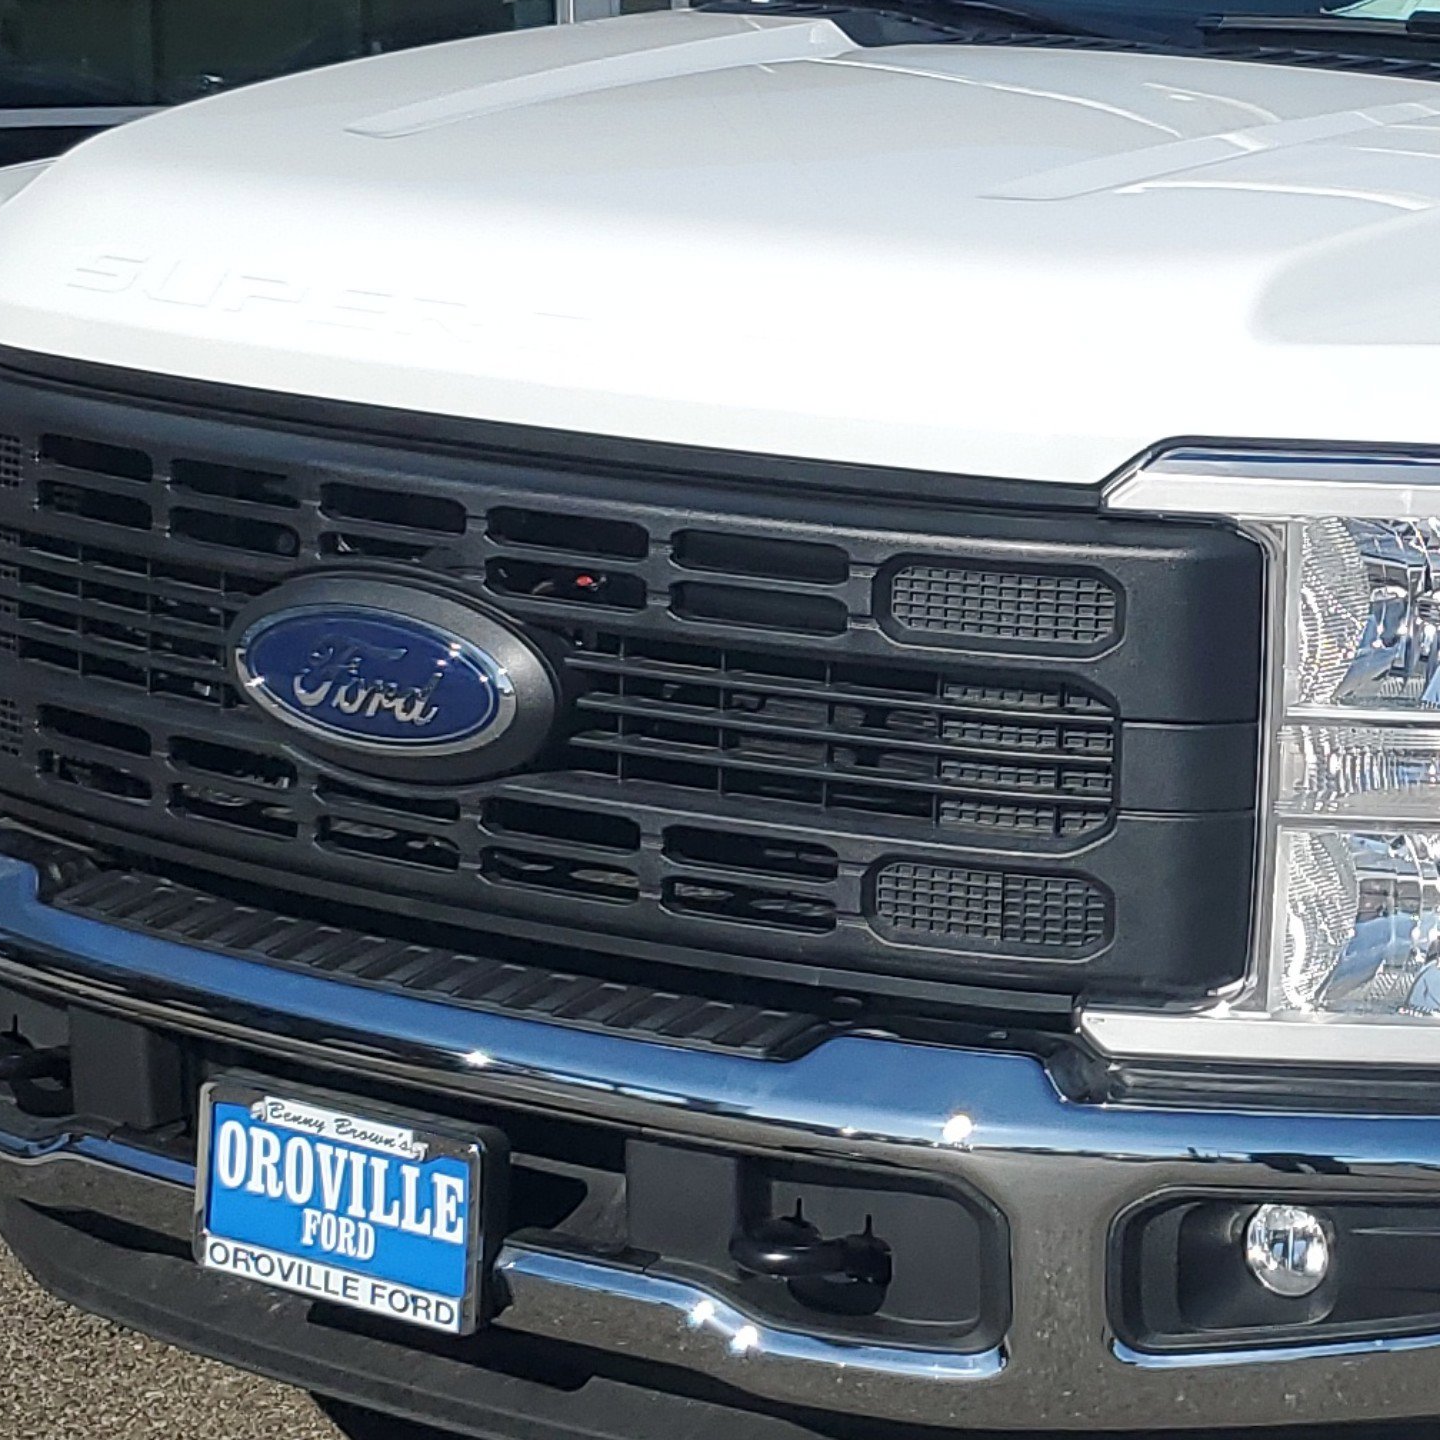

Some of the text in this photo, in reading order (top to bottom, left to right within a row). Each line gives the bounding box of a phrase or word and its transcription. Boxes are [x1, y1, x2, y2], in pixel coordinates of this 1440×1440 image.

[293, 632, 444, 727] Ford
[267, 1101, 410, 1150] Benny Brown's
[216, 1120, 465, 1245] OROVILLE
[300, 1208, 376, 1261] FORD
[208, 1241, 456, 1326] OROVILLE FORD
